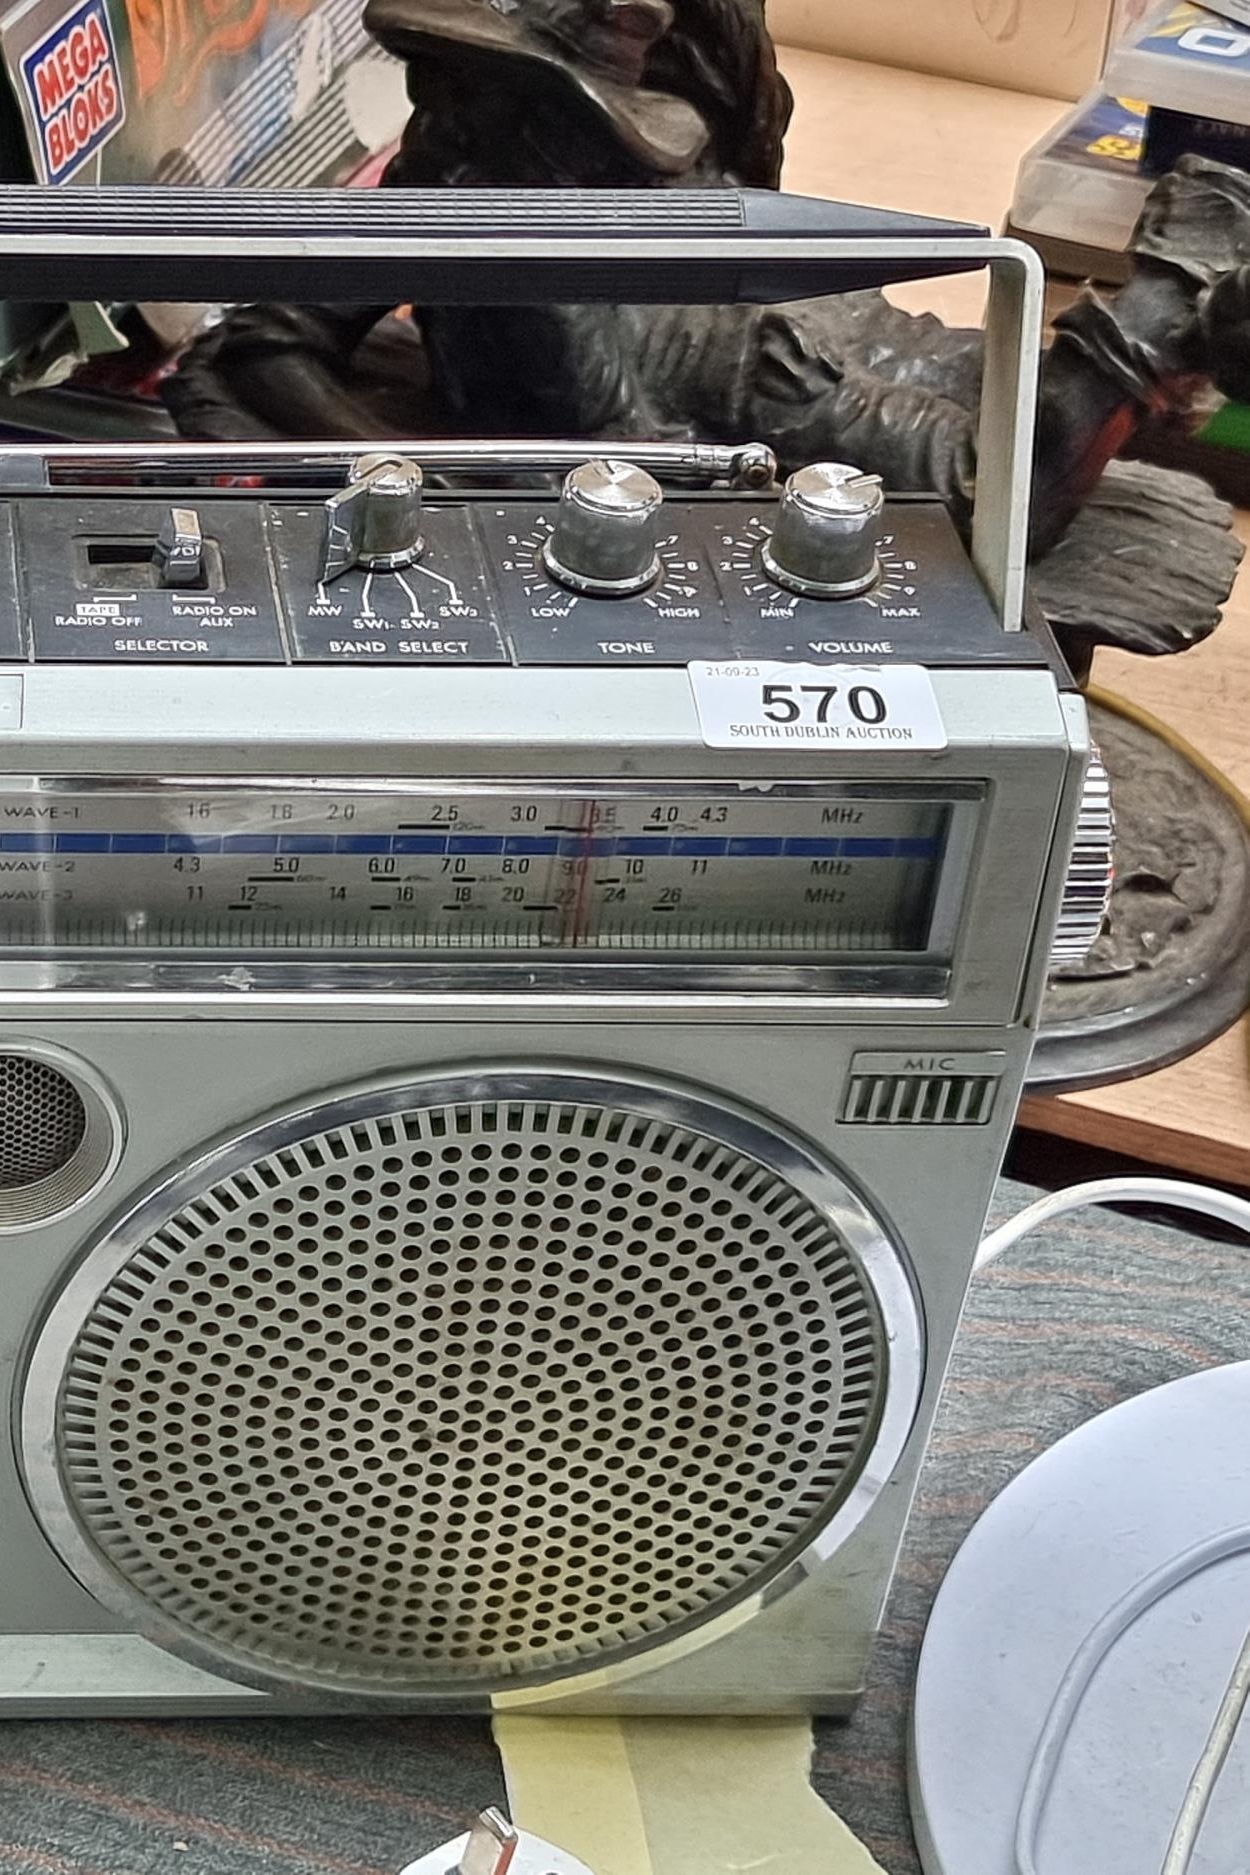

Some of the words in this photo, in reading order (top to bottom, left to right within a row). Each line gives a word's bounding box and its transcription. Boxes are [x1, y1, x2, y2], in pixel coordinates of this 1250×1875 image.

[34, 14, 108, 120] MEGA
[46, 64, 116, 174] BLOKS
[506, 535, 518, 545] 3
[667, 535, 679, 545] 7
[721, 536, 733, 545] 3
[882, 535, 894, 545] 7
[502, 561, 514, 570] 2
[719, 561, 732, 571] 2
[79, 604, 119, 615] TAPE
[172, 606, 223, 616] RADIO
[229, 606, 257, 616] ON
[308, 605, 343, 616] MW
[531, 608, 571, 618] LOW
[658, 608, 700, 618] HIGH
[760, 608, 794, 618] MIN
[881, 608, 921, 617] MAX
[55, 616, 106, 626] RADIO
[111, 616, 143, 627] OFF
[199, 618, 234, 627] AUX
[114, 640, 209, 652] SELECTOR
[329, 641, 387, 652] BAND
[398, 641, 469, 653] SELECT
[598, 642, 656, 653] TONE
[808, 642, 894, 653] VOLUME
[705, 667, 760, 677] 21-09-23
[762, 684, 888, 725] 570
[730, 725, 780, 738] SOUTH
[785, 726, 841, 739] DUBLIN
[846, 727, 913, 740] AUCTION
[326, 804, 356, 820] 2.0
[431, 805, 459, 821] 2.5
[510, 805, 538, 822] 3.0
[650, 806, 679, 823] 4.0
[700, 806, 728, 823] 4.3
[820, 807, 864, 824] MHz
[173, 857, 201, 873] 4.3
[273, 857, 300, 874] 5.0
[368, 857, 396, 874] 6.0
[441, 858, 467, 875] 7.0
[502, 858, 531, 875] 8.0
[624, 859, 645, 875] 10
[692, 859, 709, 876] 11
[809, 859, 853, 876] MHz
[186, 886, 205, 902] 11
[239, 886, 259, 902] 12
[329, 886, 347, 901] 14
[396, 886, 415, 902] 16
[454, 886, 473, 902] 18
[502, 886, 525, 902] 20
[603, 887, 628, 903] 24
[658, 887, 683, 903] 26
[803, 887, 846, 904] MHz
[904, 1058, 956, 1071] MIC
